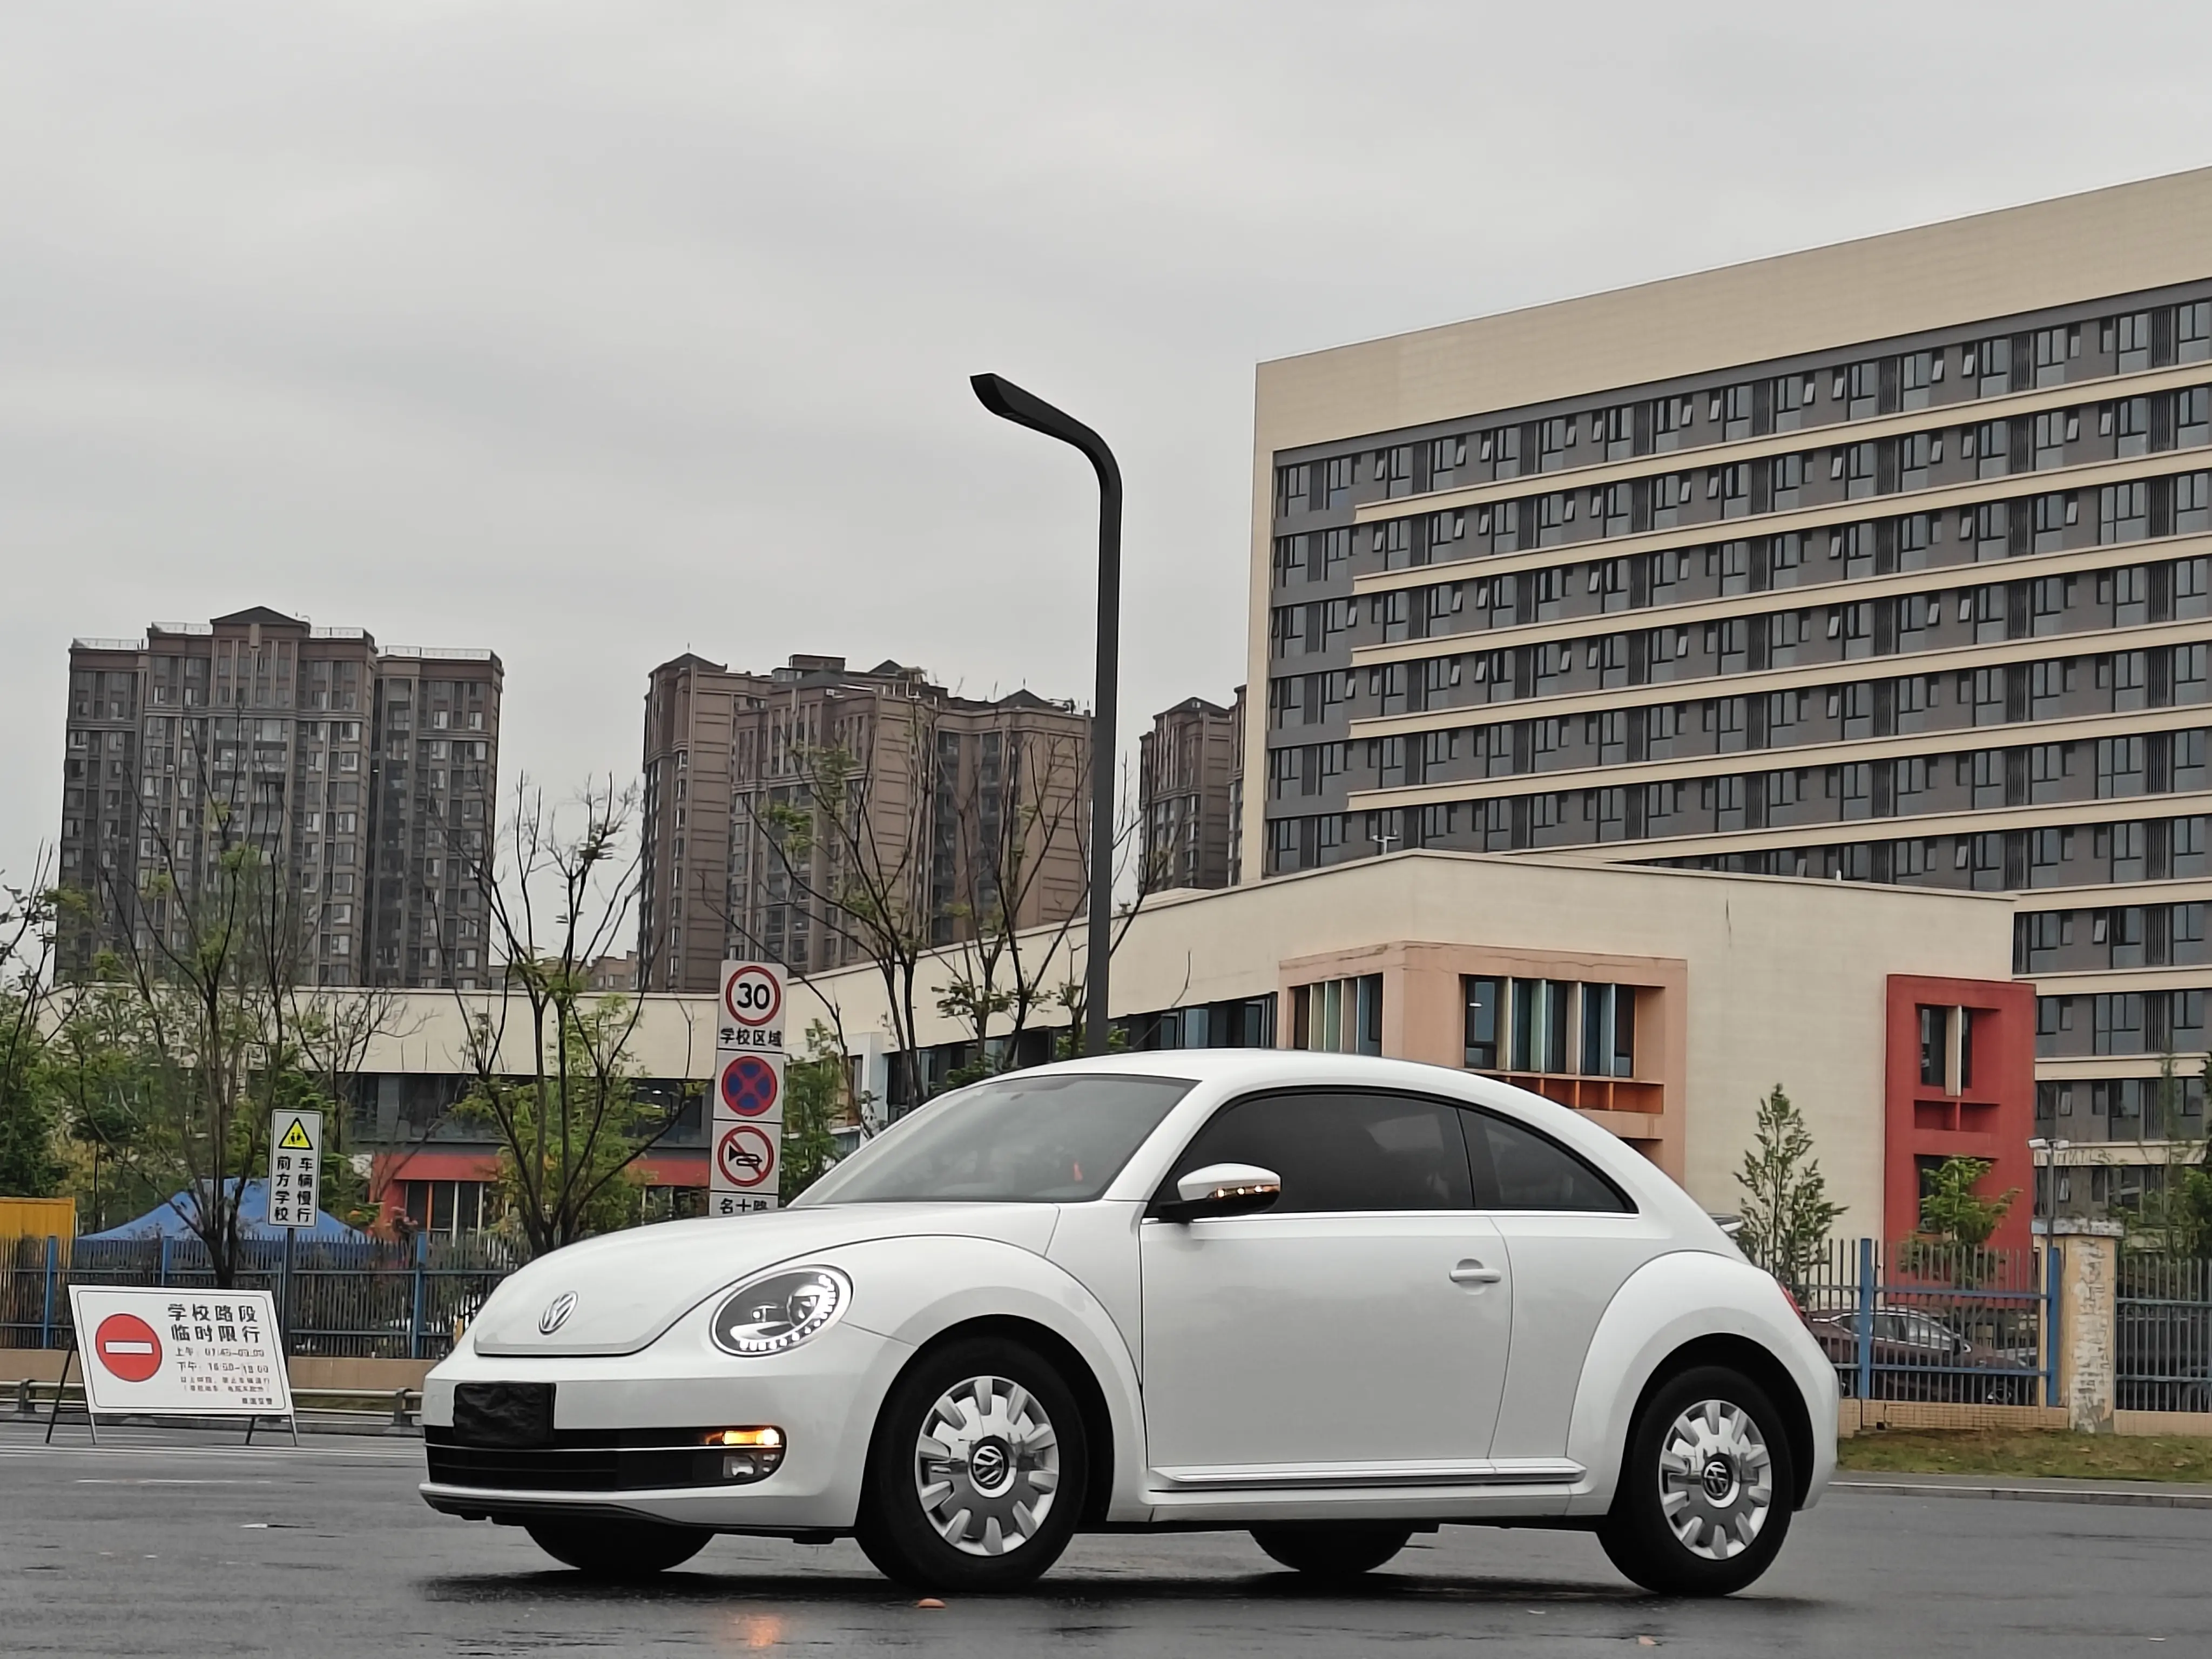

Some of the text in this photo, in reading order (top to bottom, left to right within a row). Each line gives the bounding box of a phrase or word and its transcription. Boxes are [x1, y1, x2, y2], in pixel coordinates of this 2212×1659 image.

[737, 982, 770, 1009] 30
[720, 1027, 782, 1048] 学校区域
[275, 1156, 291, 1221] 前方学校
[298, 1157, 313, 1223] 车辆慢行
[168, 1303, 258, 1322] 学校路段
[171, 1324, 260, 1343] 临时限行
